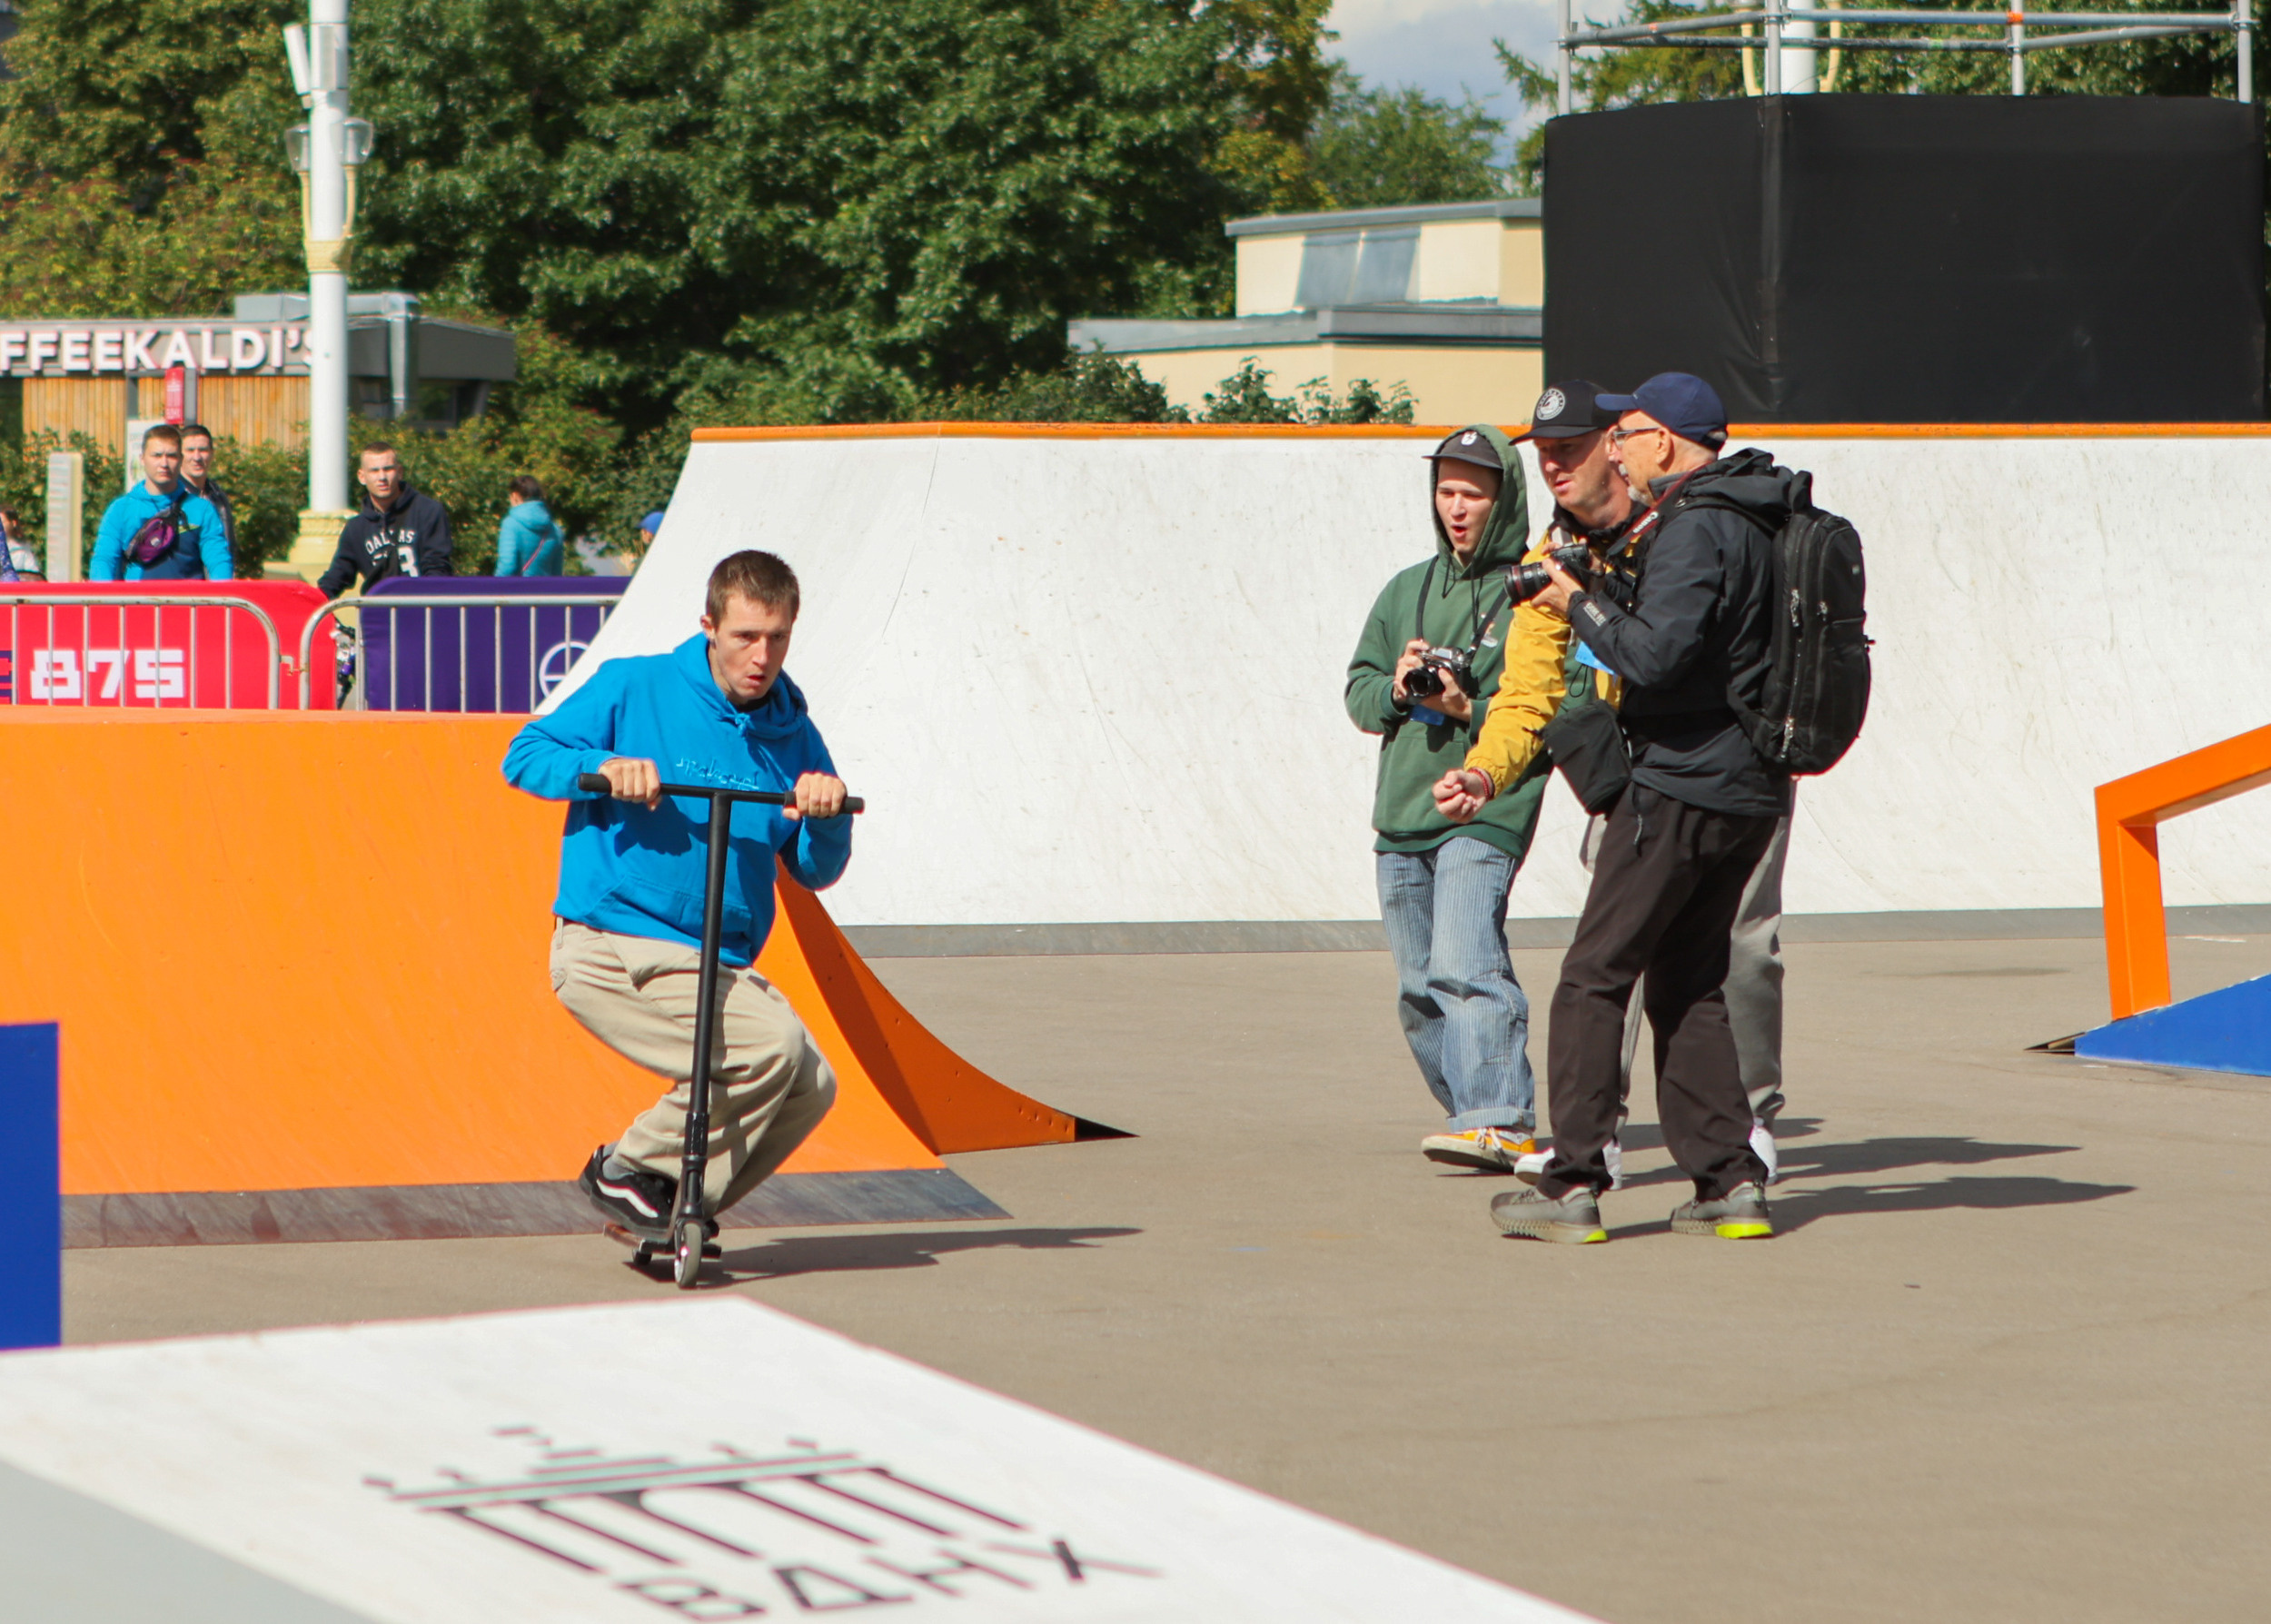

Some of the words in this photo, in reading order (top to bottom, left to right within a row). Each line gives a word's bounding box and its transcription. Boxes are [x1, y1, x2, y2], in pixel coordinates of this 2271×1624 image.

[365, 529, 415, 555] DALAS
[30, 649, 184, 699] 875
[611, 1540, 1166, 1621] ВДНХ
